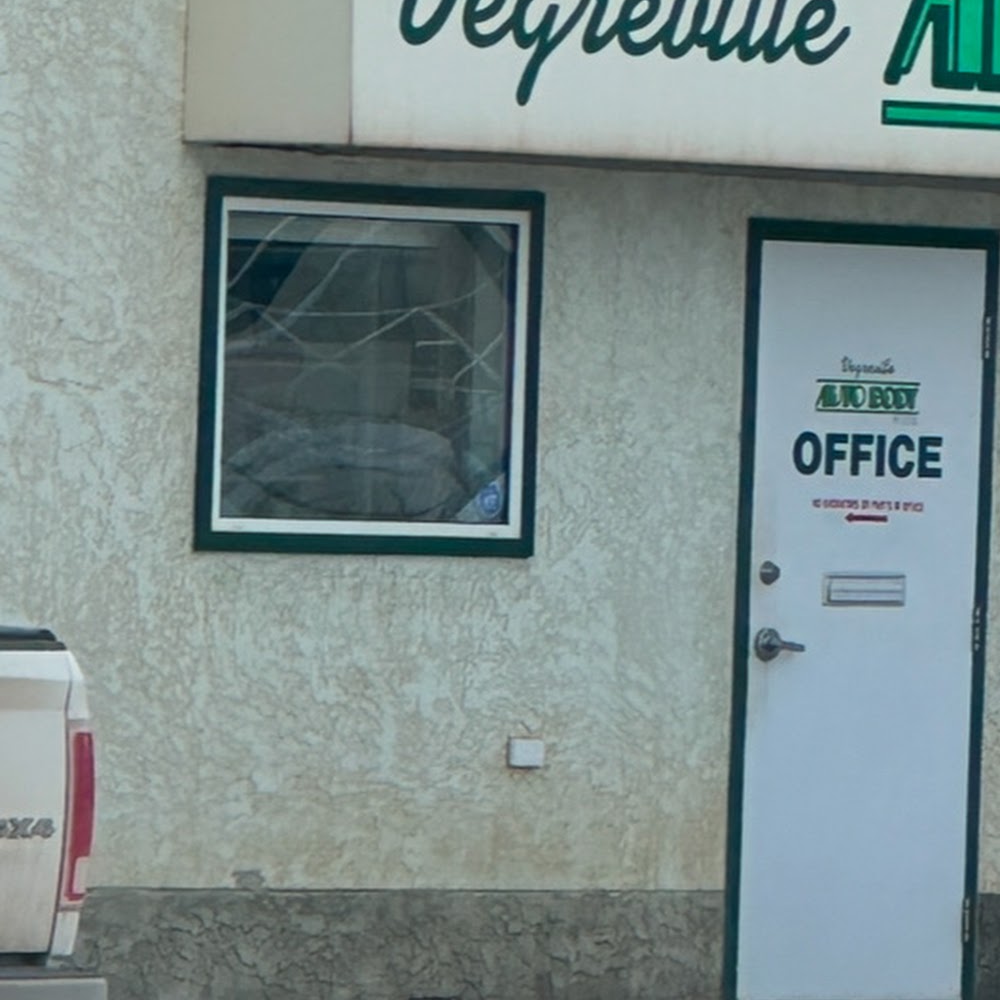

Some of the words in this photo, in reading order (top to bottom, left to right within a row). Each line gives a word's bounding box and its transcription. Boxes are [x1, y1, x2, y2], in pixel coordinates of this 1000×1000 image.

[816, 384, 866, 408] AUTO
[868, 386, 919, 410] BODY
[793, 431, 943, 479] OFFICE
